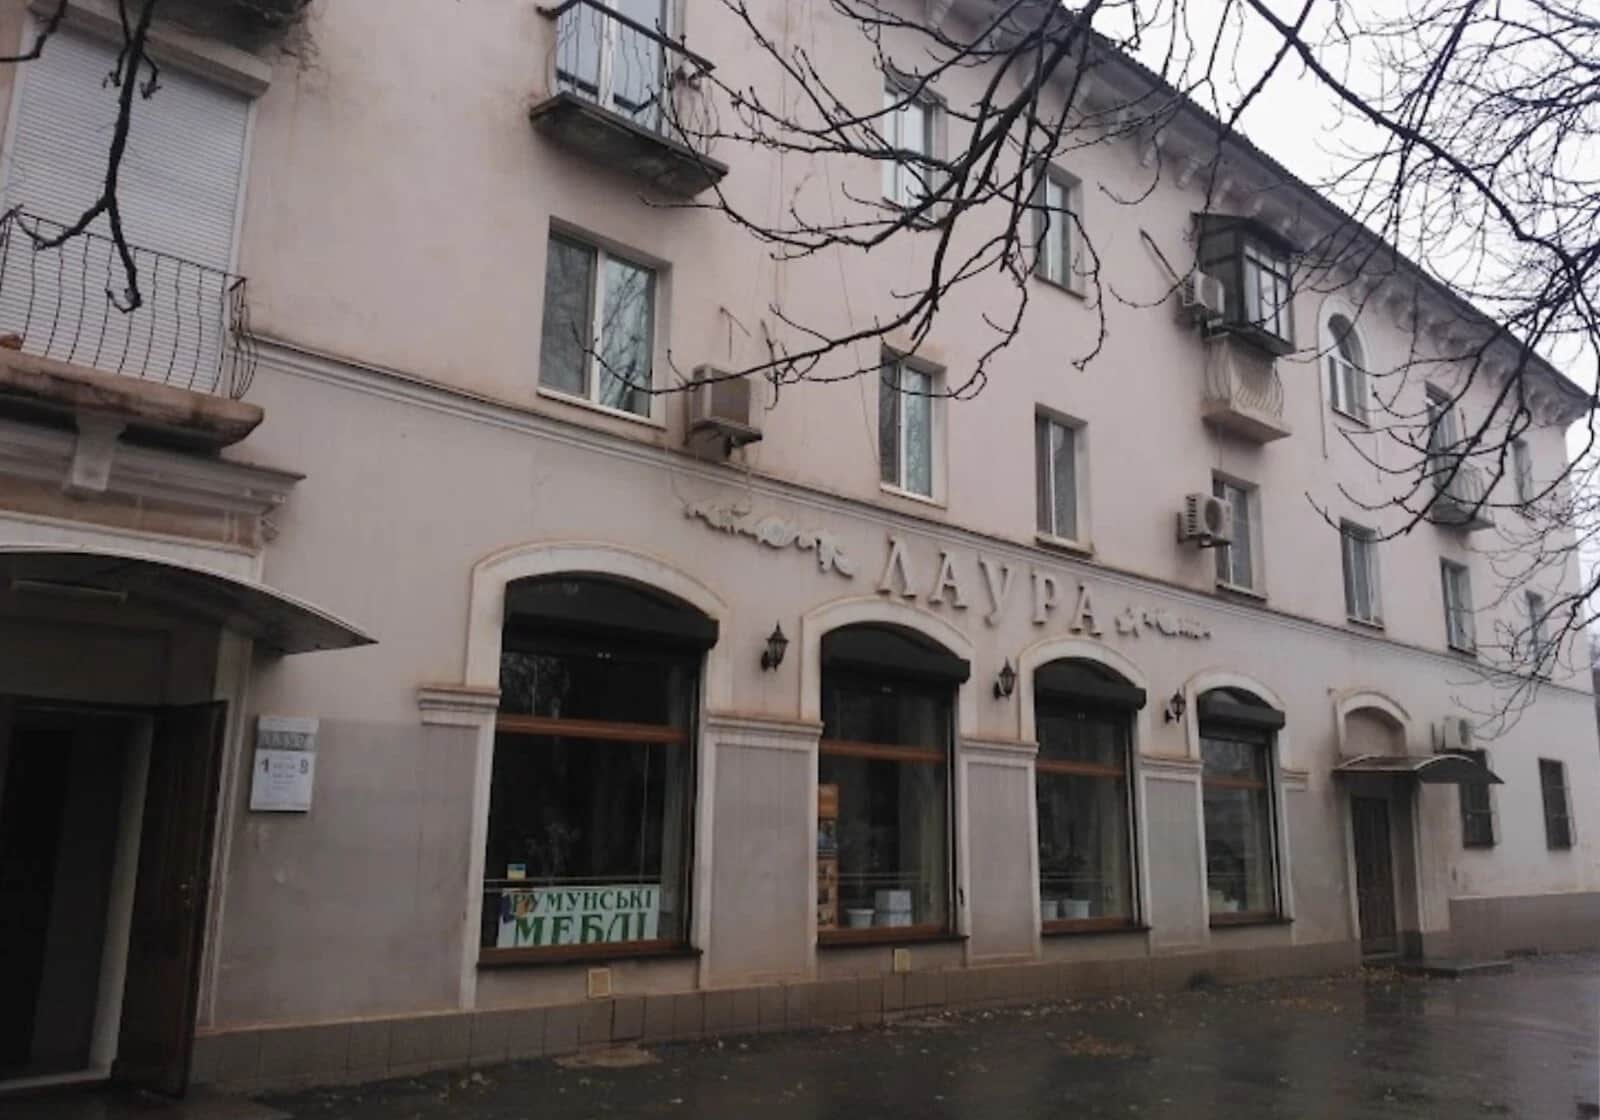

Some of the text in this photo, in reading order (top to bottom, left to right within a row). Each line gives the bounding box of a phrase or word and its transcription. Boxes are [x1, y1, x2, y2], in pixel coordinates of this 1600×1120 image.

[878, 536, 1102, 637] ЛАУРА
[512, 890, 652, 913] РУМУНСЬКІ
[514, 912, 648, 946] МЕБЛІ
